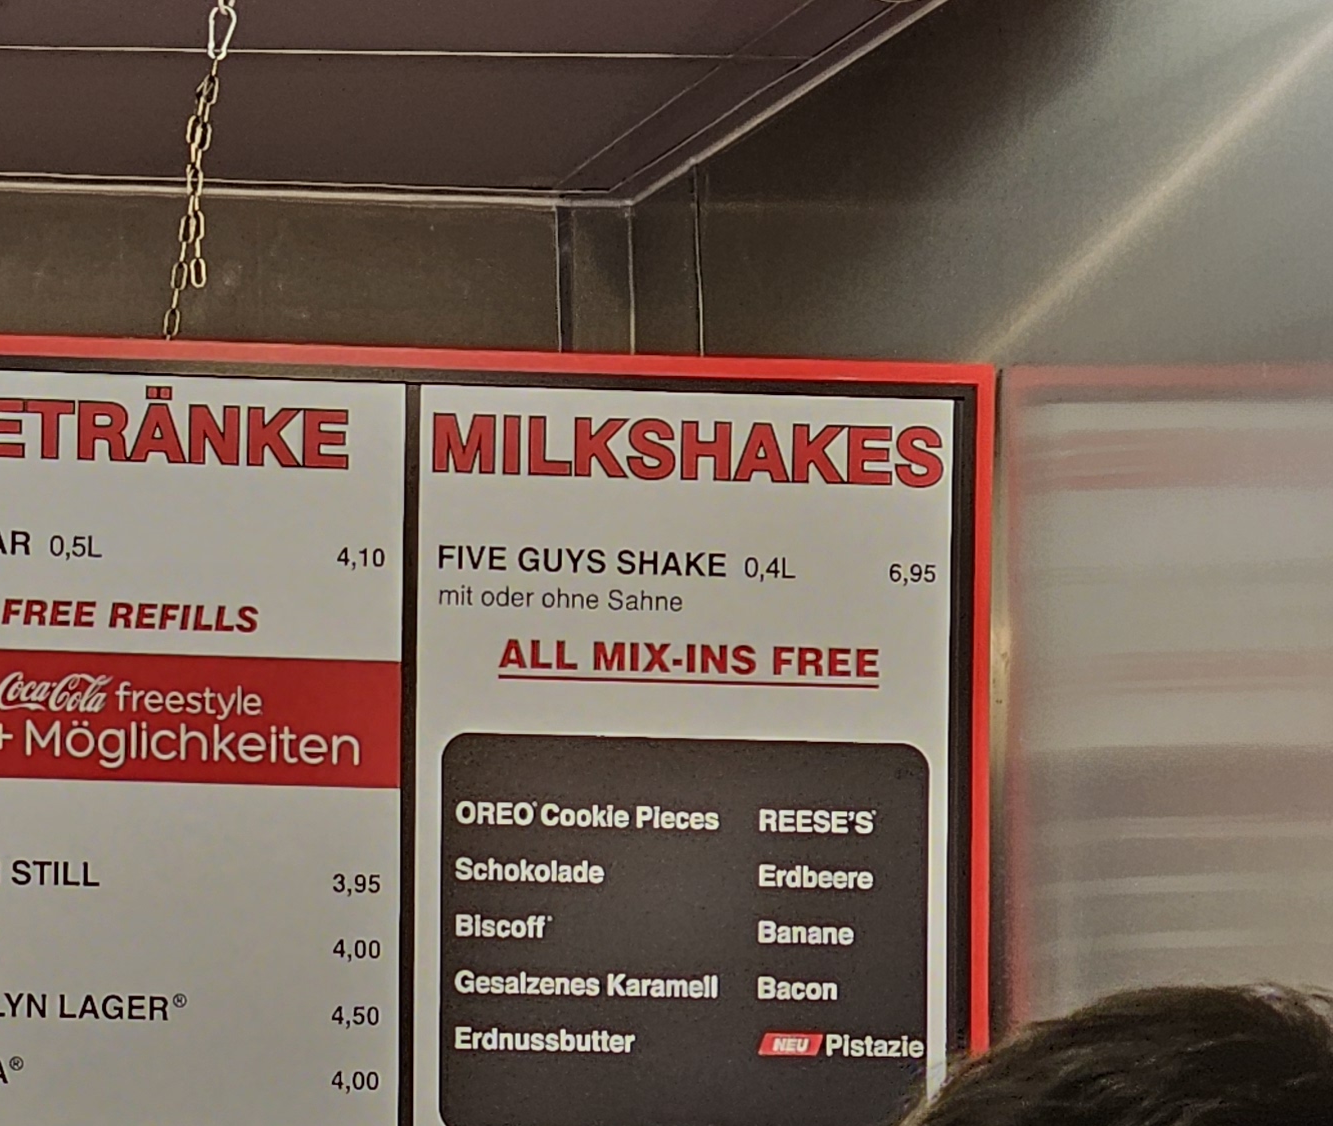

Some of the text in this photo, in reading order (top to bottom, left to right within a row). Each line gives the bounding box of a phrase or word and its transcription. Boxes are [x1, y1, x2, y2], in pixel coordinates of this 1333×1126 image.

[432, 412, 943, 488] MILKSHAKES
[50, 535, 102, 560] 0,5L
[337, 547, 385, 570] 4,10
[439, 545, 935, 586] FIVE GUYS SHAKE 0,4L 6,95
[439, 585, 682, 612] mit oder ohne Sahne
[2, 599, 258, 632] FREE REFILLS
[499, 639, 879, 677] ALL MIX-INS FREE
[115, 681, 261, 720] freestyle
[26, 720, 359, 768] Möglichkeiten
[12, 860, 99, 886] STILL
[333, 874, 380, 896] 3,95
[456, 857, 604, 883] Schokolade
[759, 864, 873, 889] Erdbeere
[758, 920, 854, 945] Banane
[455, 970, 718, 998] Gesalzenes Karamell
[758, 977, 837, 1000] Bacon
[332, 1006, 378, 1028] 4,50
[455, 1027, 635, 1053] Erdnussbutter
[772, 1034, 924, 1058] NEU Pistazie
